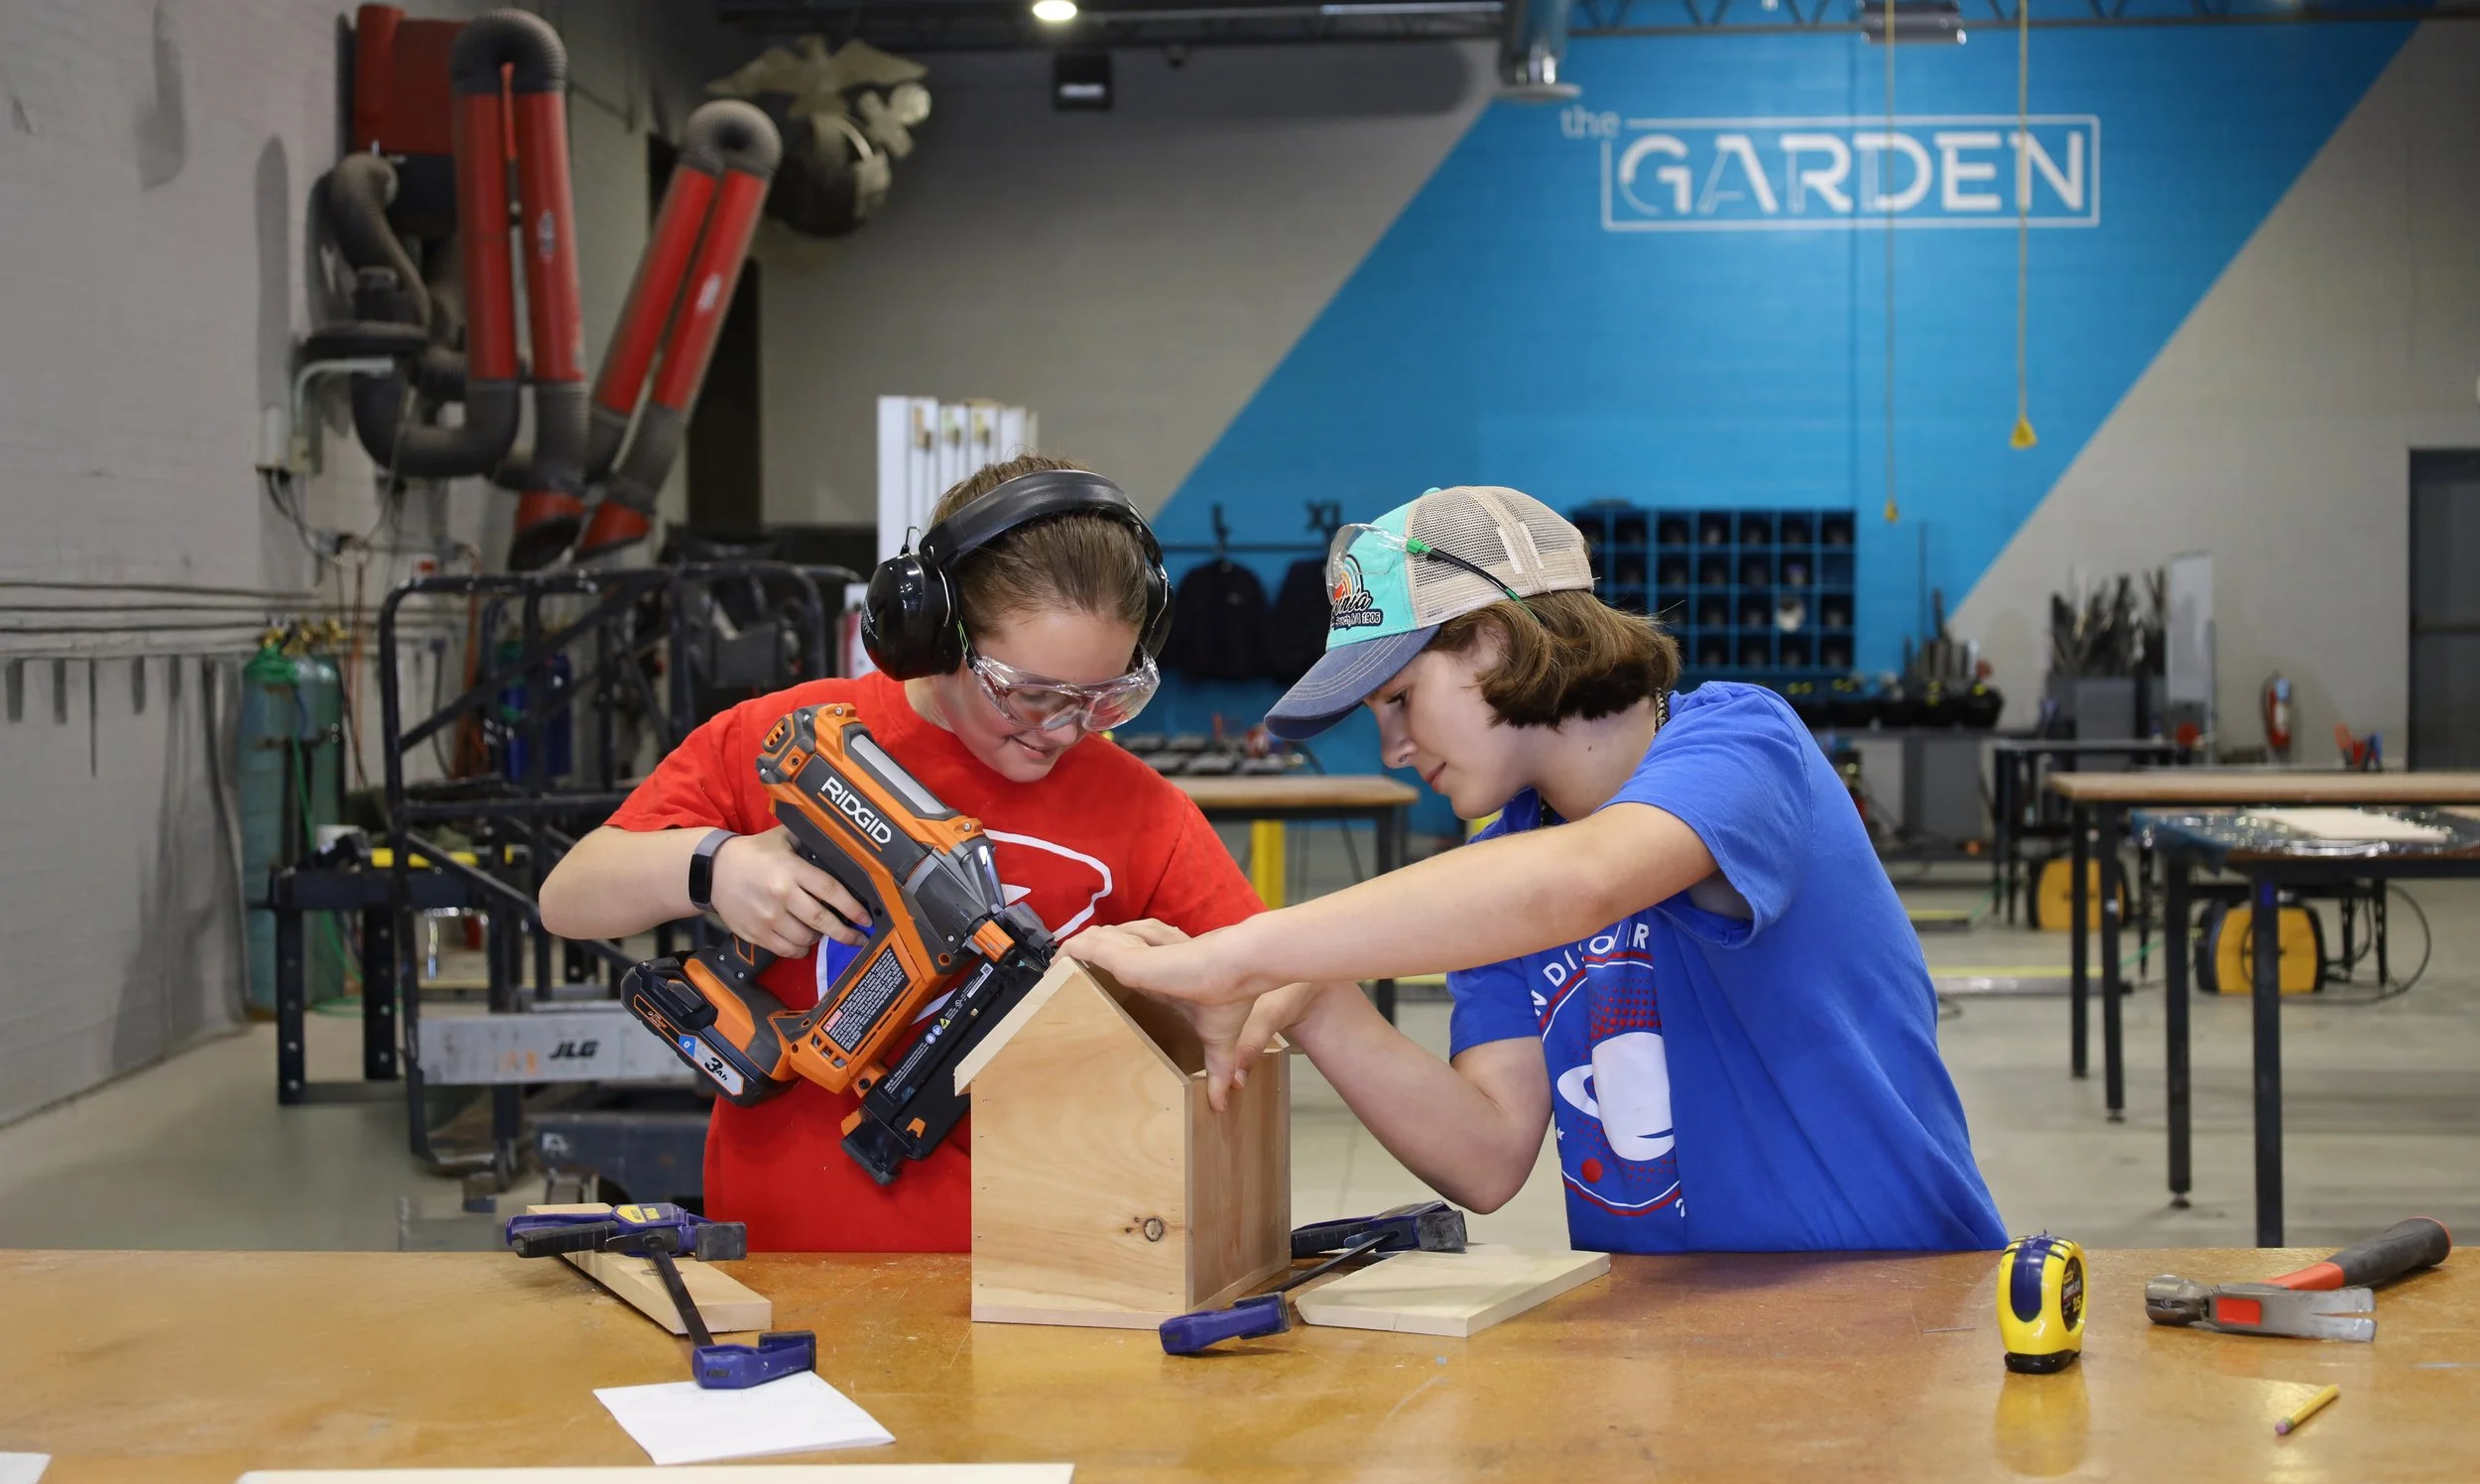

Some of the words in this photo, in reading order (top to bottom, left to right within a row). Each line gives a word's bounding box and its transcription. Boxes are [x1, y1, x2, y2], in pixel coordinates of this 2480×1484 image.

[1560, 105, 1621, 139] the
[1618, 132, 2083, 215] GARDEN
[820, 776, 892, 844] RIDGID
[549, 1041, 599, 1060] JLG
